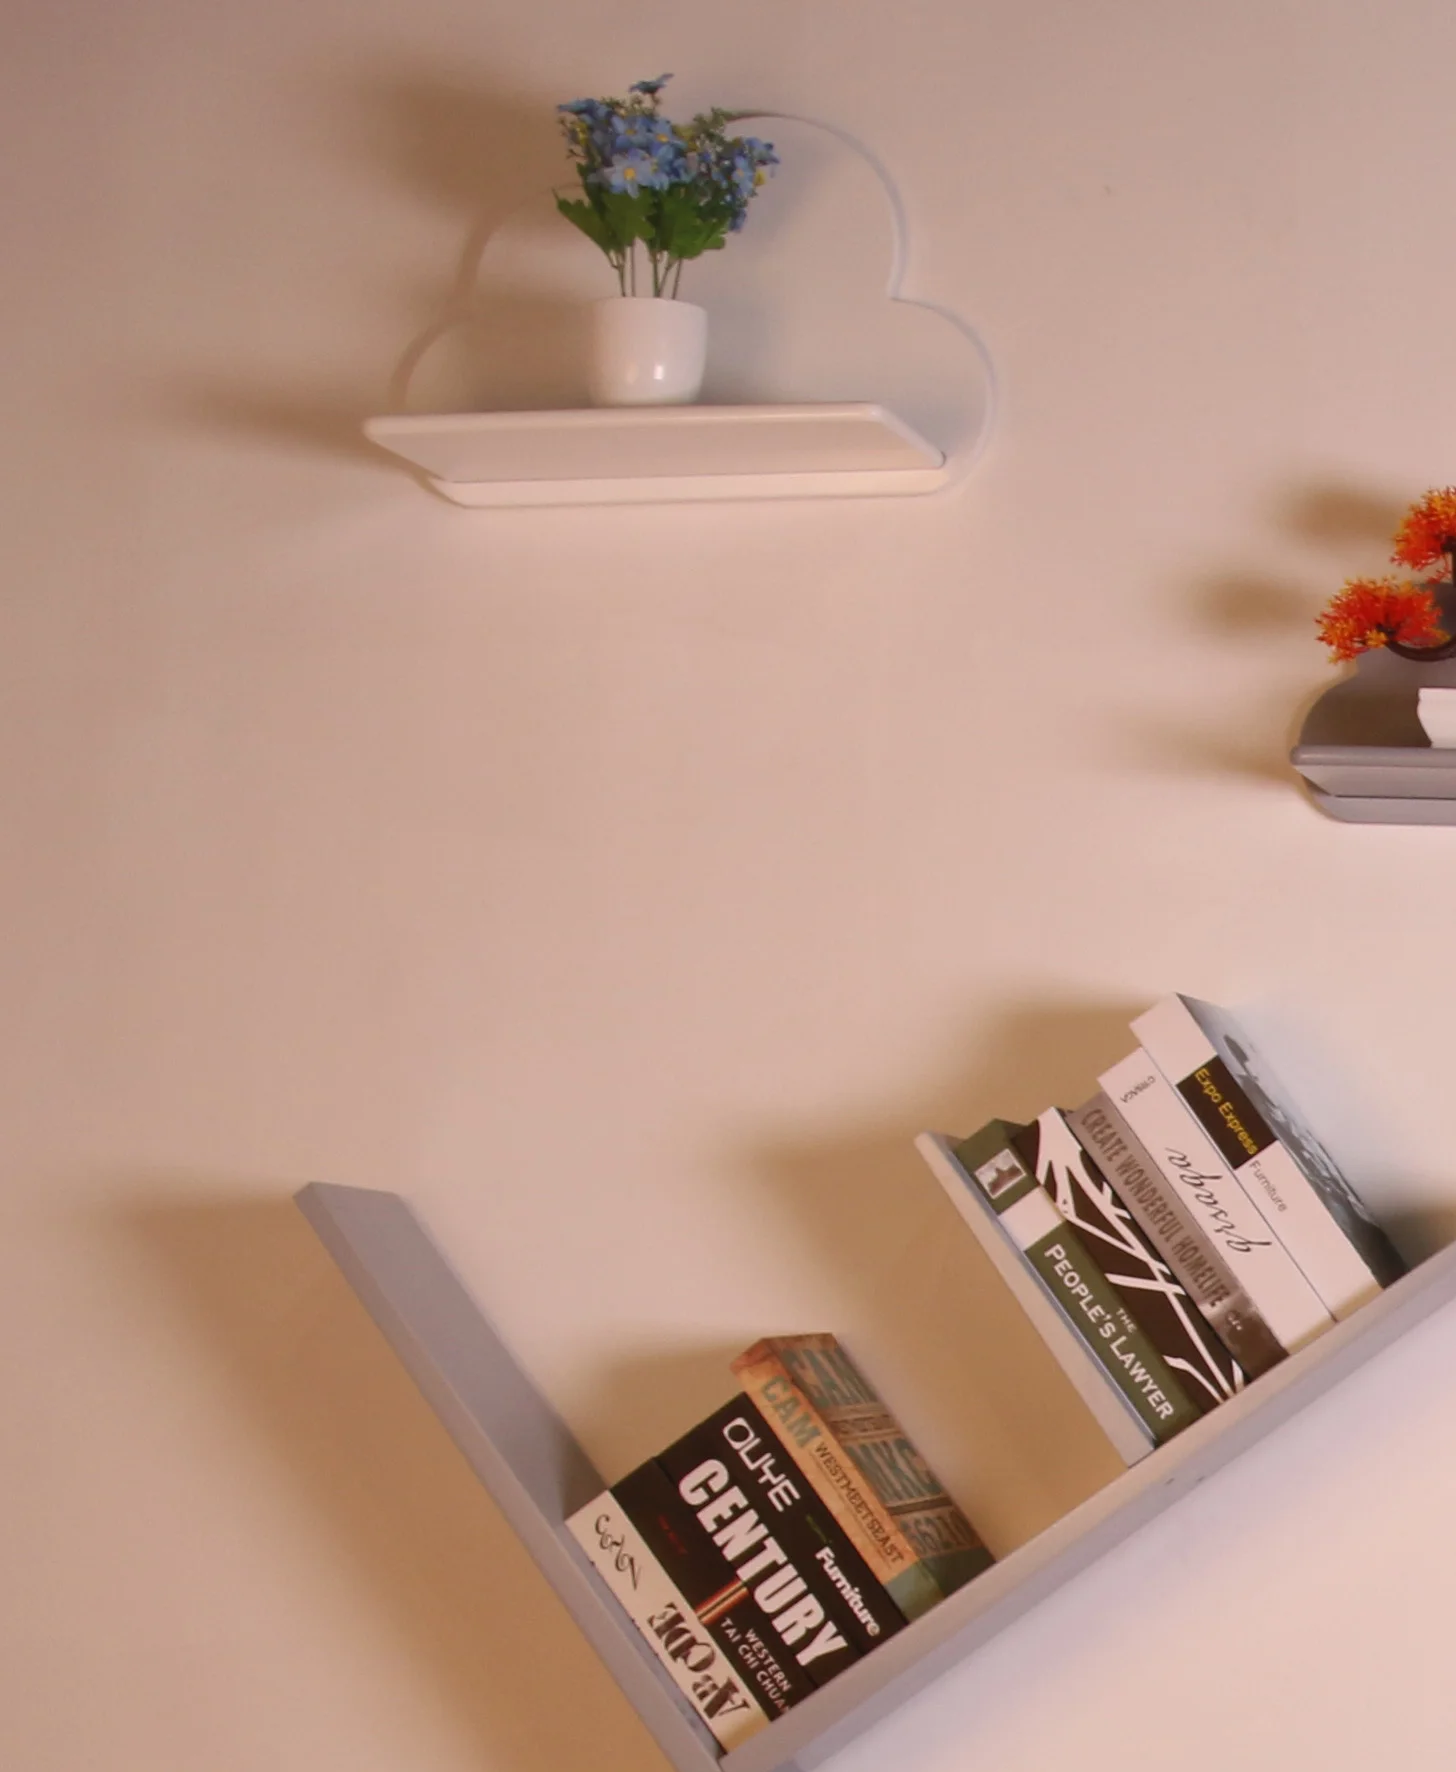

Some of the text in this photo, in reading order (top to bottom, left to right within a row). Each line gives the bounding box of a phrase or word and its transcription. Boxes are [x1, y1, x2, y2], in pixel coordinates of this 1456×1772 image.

[1192, 1067, 1262, 1157] Expo Express
[1078, 1106, 1129, 1164] CREATE
[1112, 1153, 1187, 1245] WONDERFUL
[1170, 1234, 1232, 1309] HOMELIFE
[1247, 1159, 1291, 1214] Furniture
[1044, 1243, 1174, 1420] PEOPLE'S LAWYER
[1115, 1307, 1137, 1334] THE
[758, 1373, 823, 1449] CAM
[812, 1442, 905, 1567] WESTMEETSEAST
[678, 1458, 847, 1667] CENTURY
[815, 1546, 881, 1637] Furniture
[718, 1616, 761, 1671] TAI CHI
[742, 1628, 793, 1694] WESTERN
